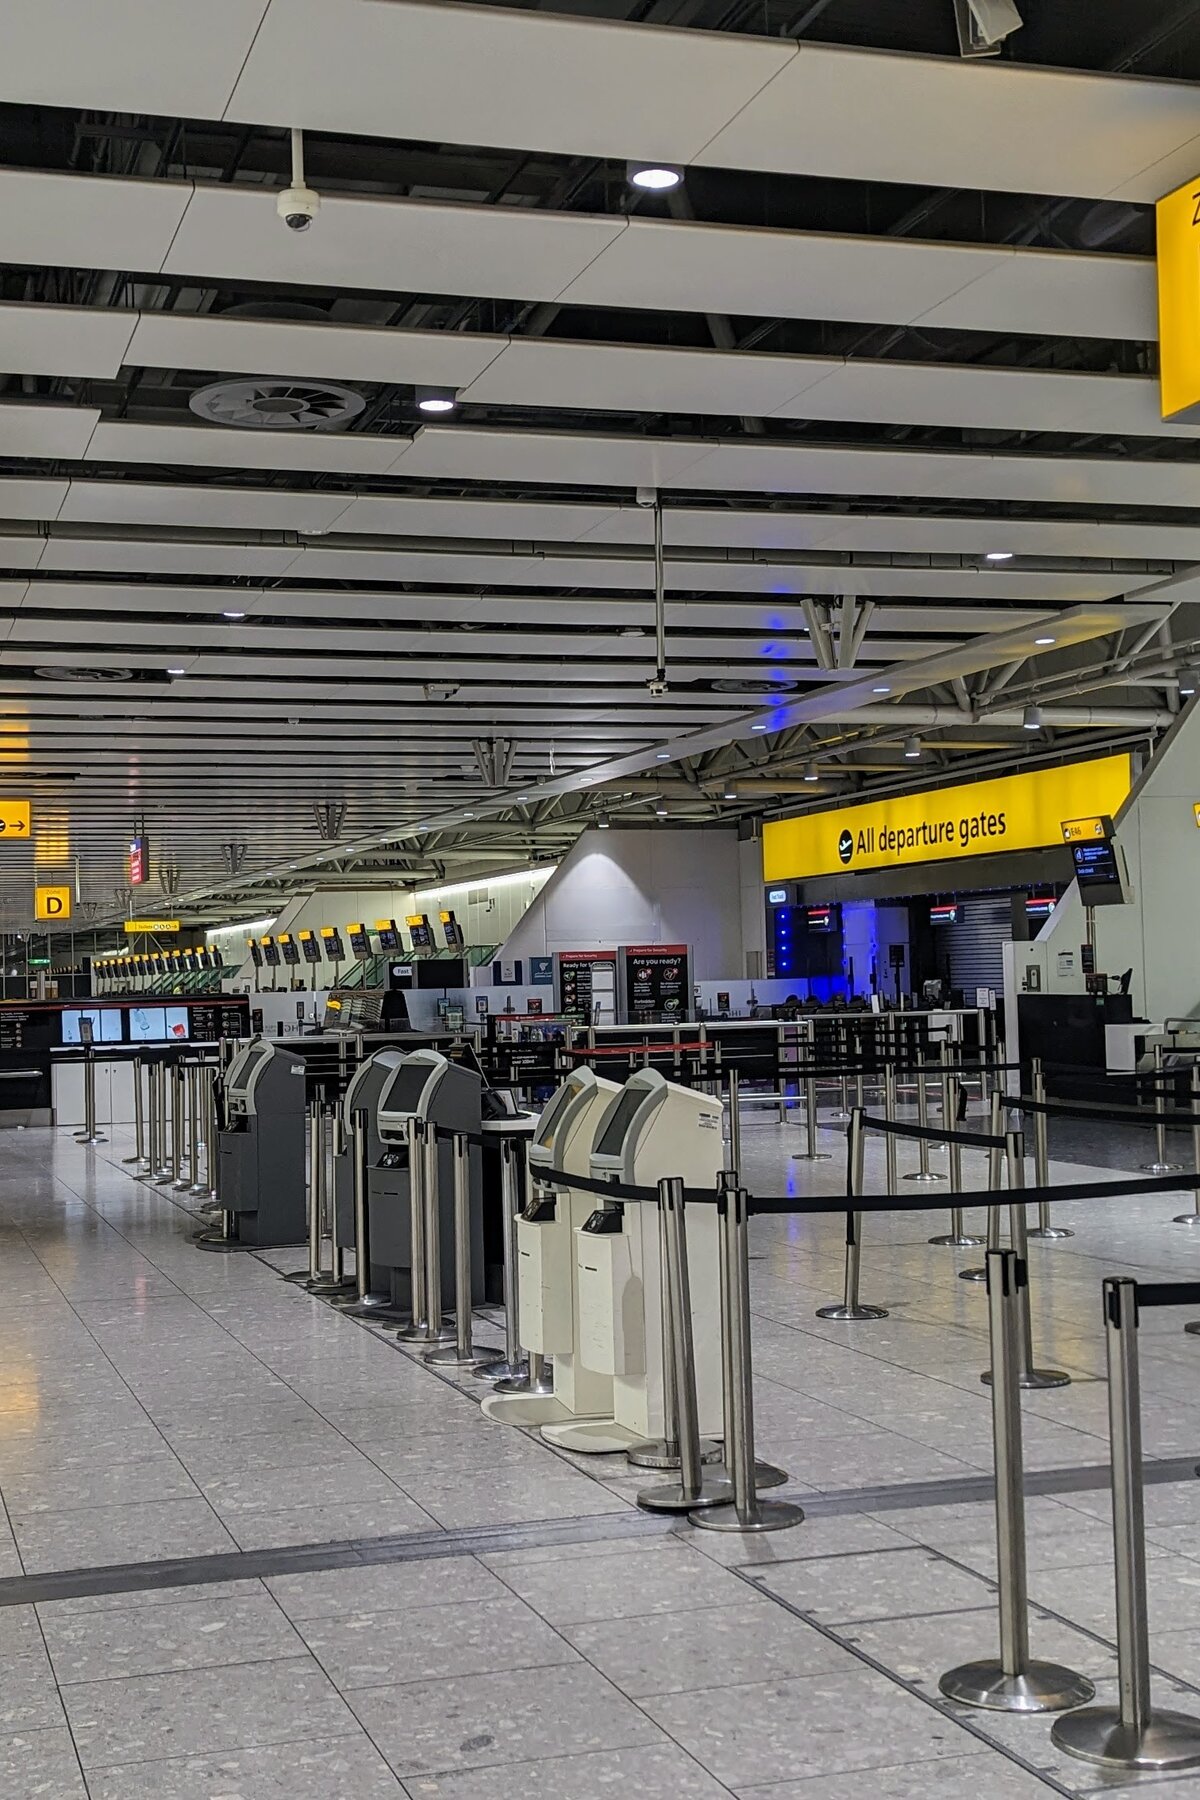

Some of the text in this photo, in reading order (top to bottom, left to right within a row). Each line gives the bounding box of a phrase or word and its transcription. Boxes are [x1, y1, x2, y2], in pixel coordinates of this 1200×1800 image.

[856, 811, 1007, 857] All departure gates
[46, 896, 63, 914] D
[659, 957, 682, 966] ready?
